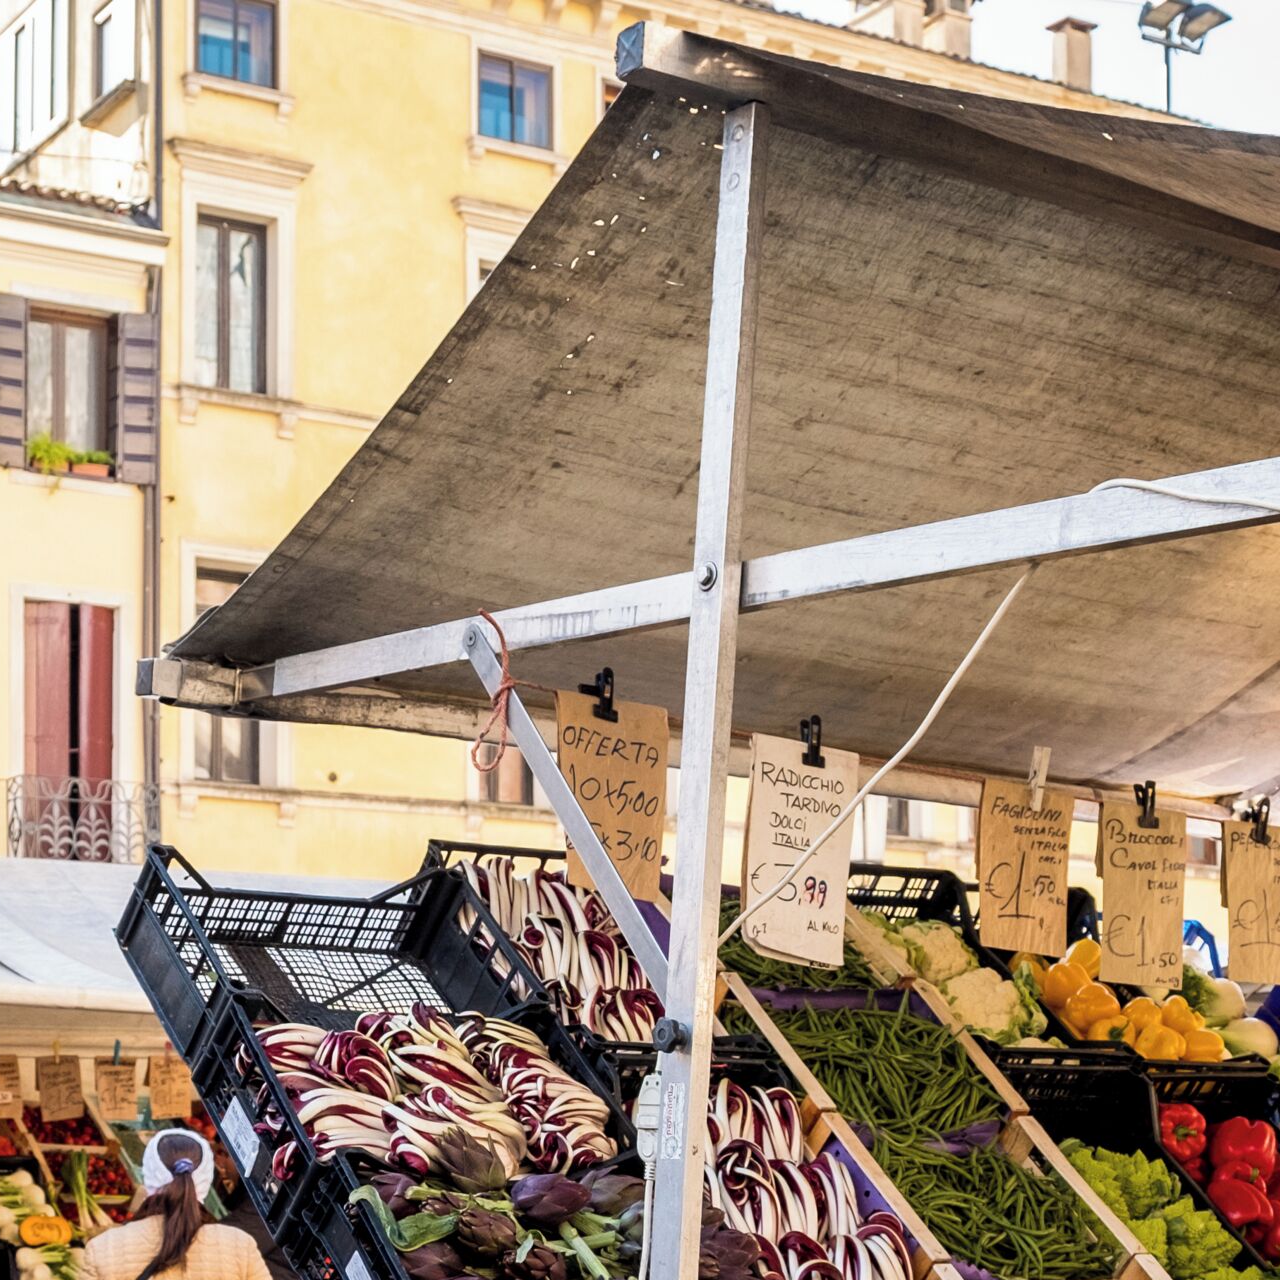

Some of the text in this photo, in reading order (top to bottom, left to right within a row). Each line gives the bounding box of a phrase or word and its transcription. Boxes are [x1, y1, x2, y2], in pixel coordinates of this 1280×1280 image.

[562, 725, 660, 769] OFFERTA
[760, 761, 845, 795] RADICCHIO
[780, 792, 842, 818] TARDIVO
[774, 832, 811, 848] ITALIA
[1105, 818, 1185, 848] BROCCOLI
